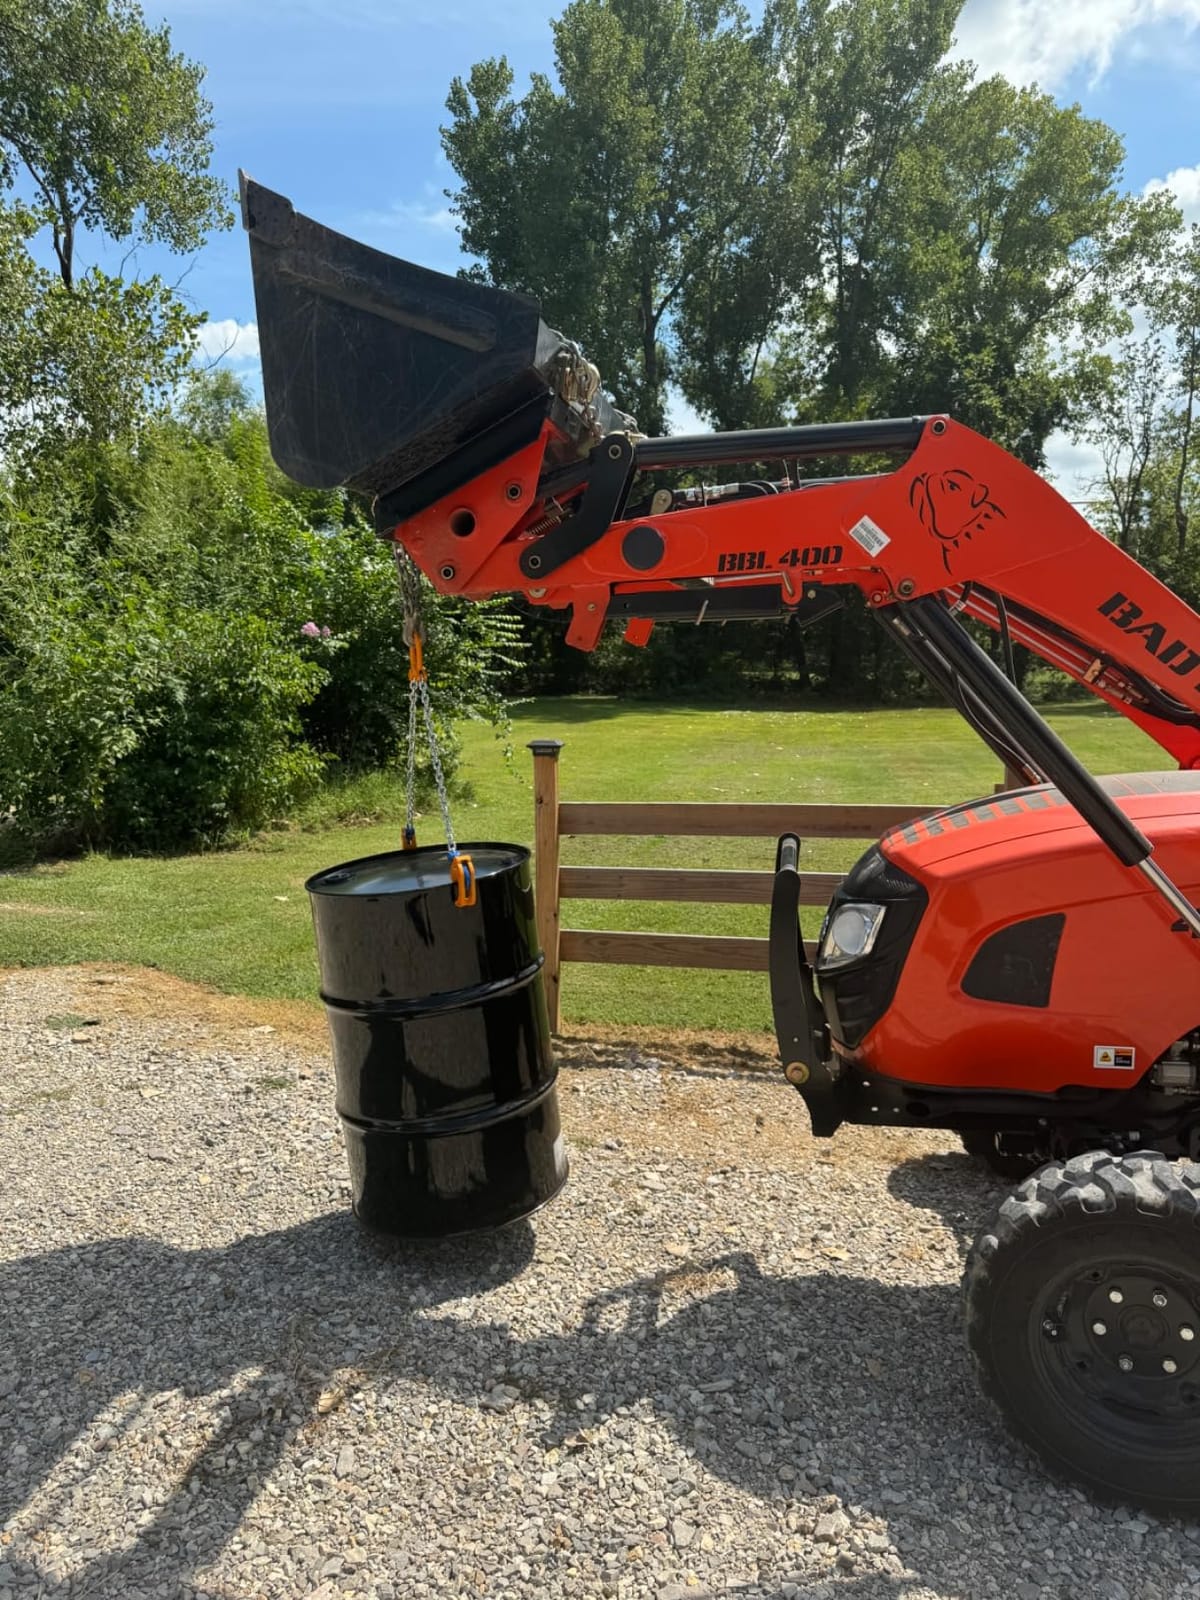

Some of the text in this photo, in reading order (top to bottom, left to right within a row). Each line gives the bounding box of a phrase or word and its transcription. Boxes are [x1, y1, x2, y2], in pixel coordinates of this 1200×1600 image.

[718, 546, 843, 572] BBL 400
[1097, 591, 1200, 675] BAD
